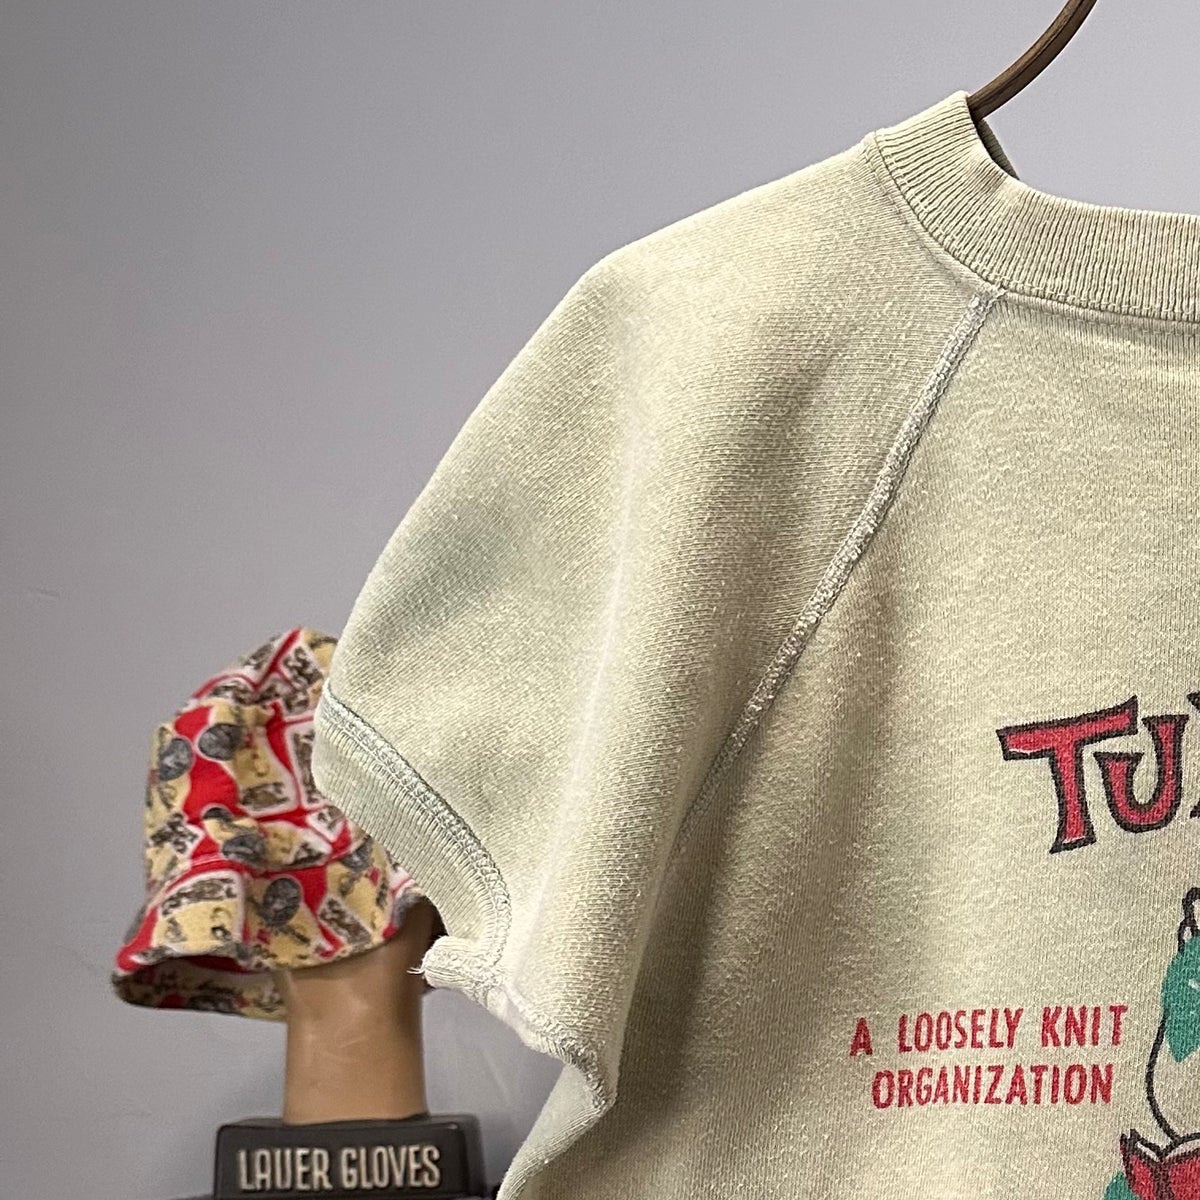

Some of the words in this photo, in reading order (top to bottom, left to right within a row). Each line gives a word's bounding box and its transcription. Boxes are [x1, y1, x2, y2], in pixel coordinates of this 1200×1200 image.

[852, 1020, 872, 1055] A
[900, 1010, 1023, 1053] LOOSELY
[1042, 1006, 1127, 1047] KNIT
[874, 1065, 1113, 1109] ORGANIZATION
[237, 1147, 333, 1192] LAUER
[340, 1144, 442, 1190] GLOVES
